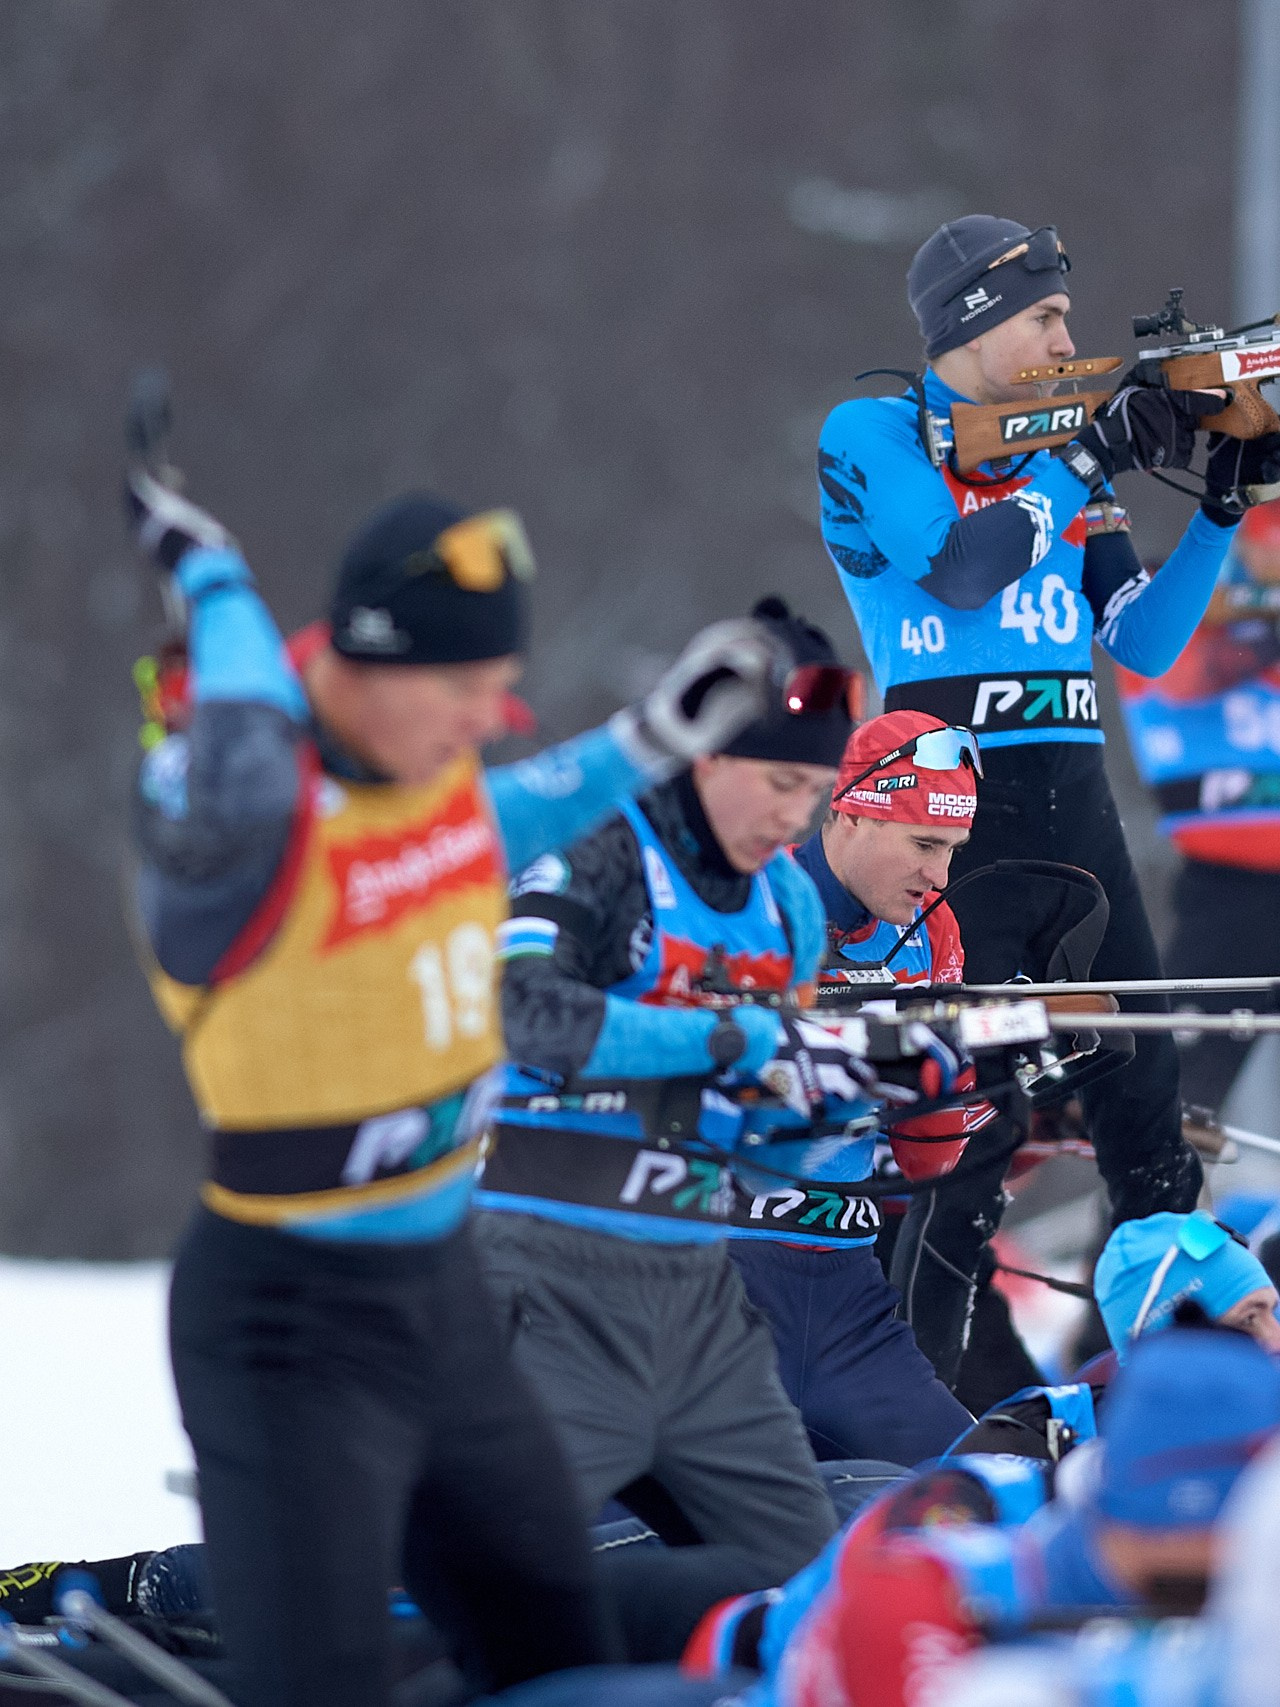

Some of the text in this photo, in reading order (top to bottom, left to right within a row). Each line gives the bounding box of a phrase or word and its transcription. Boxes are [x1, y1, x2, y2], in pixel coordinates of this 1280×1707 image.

[961, 295, 1003, 324] NORDSKI
[1004, 406, 1084, 440] PARI
[1001, 574, 1080, 644] 40
[901, 615, 946, 655] 40
[972, 679, 1098, 725] PARI
[877, 775, 915, 792] PARI
